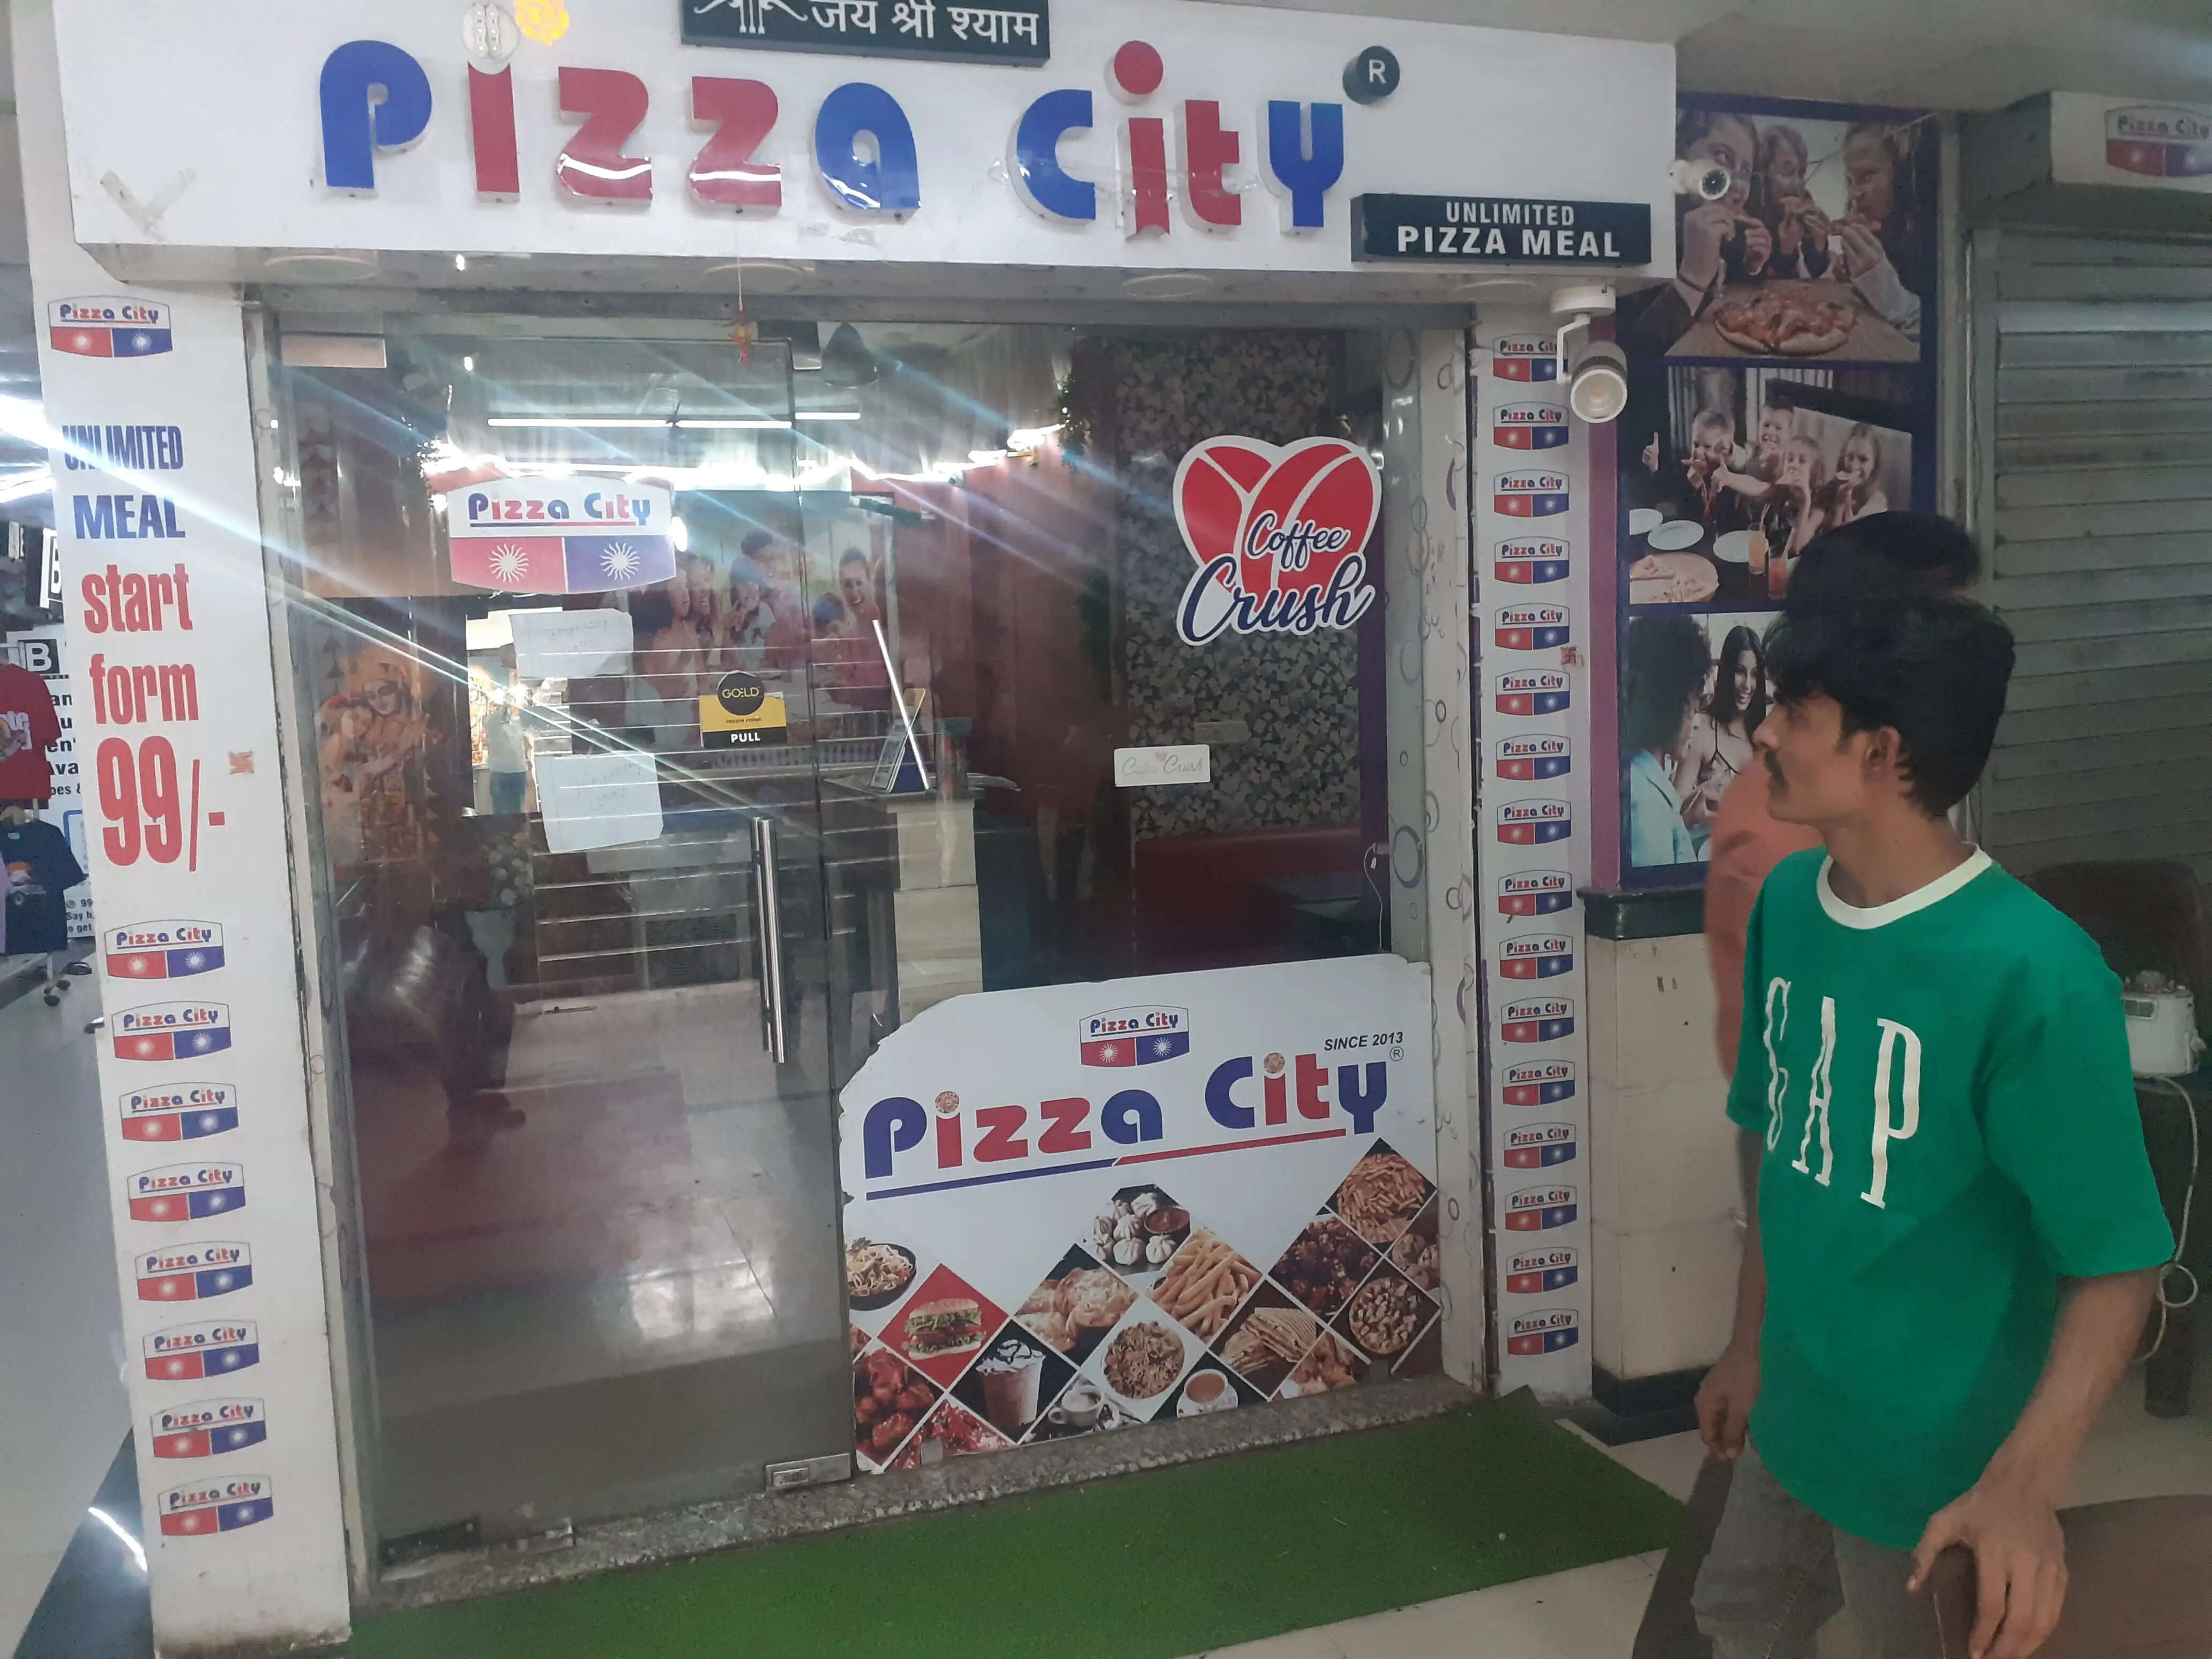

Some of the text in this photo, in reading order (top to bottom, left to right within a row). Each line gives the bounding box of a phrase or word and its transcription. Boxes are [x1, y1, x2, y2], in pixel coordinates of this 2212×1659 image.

[811, 1, 878, 34] जय
[947, 7, 1039, 46] श्याम
[319, 3, 922, 213] Pizza
[1017, 40, 1344, 234] City
[1446, 201, 1575, 226] UNLIMITED
[1398, 226, 1620, 257] PIZZA MEAL
[60, 301, 159, 324] Pizza City
[1500, 340, 1534, 352] Pizza
[1501, 407, 1561, 422] Pizza City
[1501, 475, 1562, 490] Pizza City
[73, 495, 185, 539] MEAL
[468, 491, 651, 526] Pizza City
[1247, 513, 1346, 567] Coffee
[1502, 542, 1562, 556] Pizza City
[81, 564, 193, 633] start
[1182, 555, 1371, 642] Crush
[1503, 609, 1563, 622] Pizza City
[89, 654, 199, 724] form
[1503, 674, 1563, 687] Pizza City
[731, 732, 760, 743] PULL
[1504, 739, 1564, 753] Pizza City
[96, 736, 225, 872] 99/-
[1504, 804, 1564, 818] Pizza City
[1505, 875, 1565, 889] Pizza City
[116, 924, 212, 946] Pizza City
[1507, 939, 1566, 953] Pizza City
[123, 1007, 219, 1028] Pizza City
[1508, 1002, 1567, 1017] Pizza City
[1090, 1011, 1178, 1033] Pizza City
[1324, 1032, 1403, 1051] SINCE 2013
[1509, 1065, 1568, 1080] Pizza City
[131, 1088, 225, 1109] Pizza City
[863, 1088, 1163, 1179] Pizza
[1204, 1052, 1387, 1134] City
[1511, 1127, 1569, 1143] Pizza City
[138, 1168, 232, 1190] Pizza City
[1512, 1190, 1570, 1205] Pizza City
[146, 1247, 240, 1270] Pizza City
[1514, 1252, 1571, 1269] Pizza City
[1514, 1314, 1572, 1331] Pizza City
[154, 1327, 246, 1349] Pizza City
[162, 1404, 254, 1428] Pizza City
[170, 1482, 261, 1506] Pizza City
